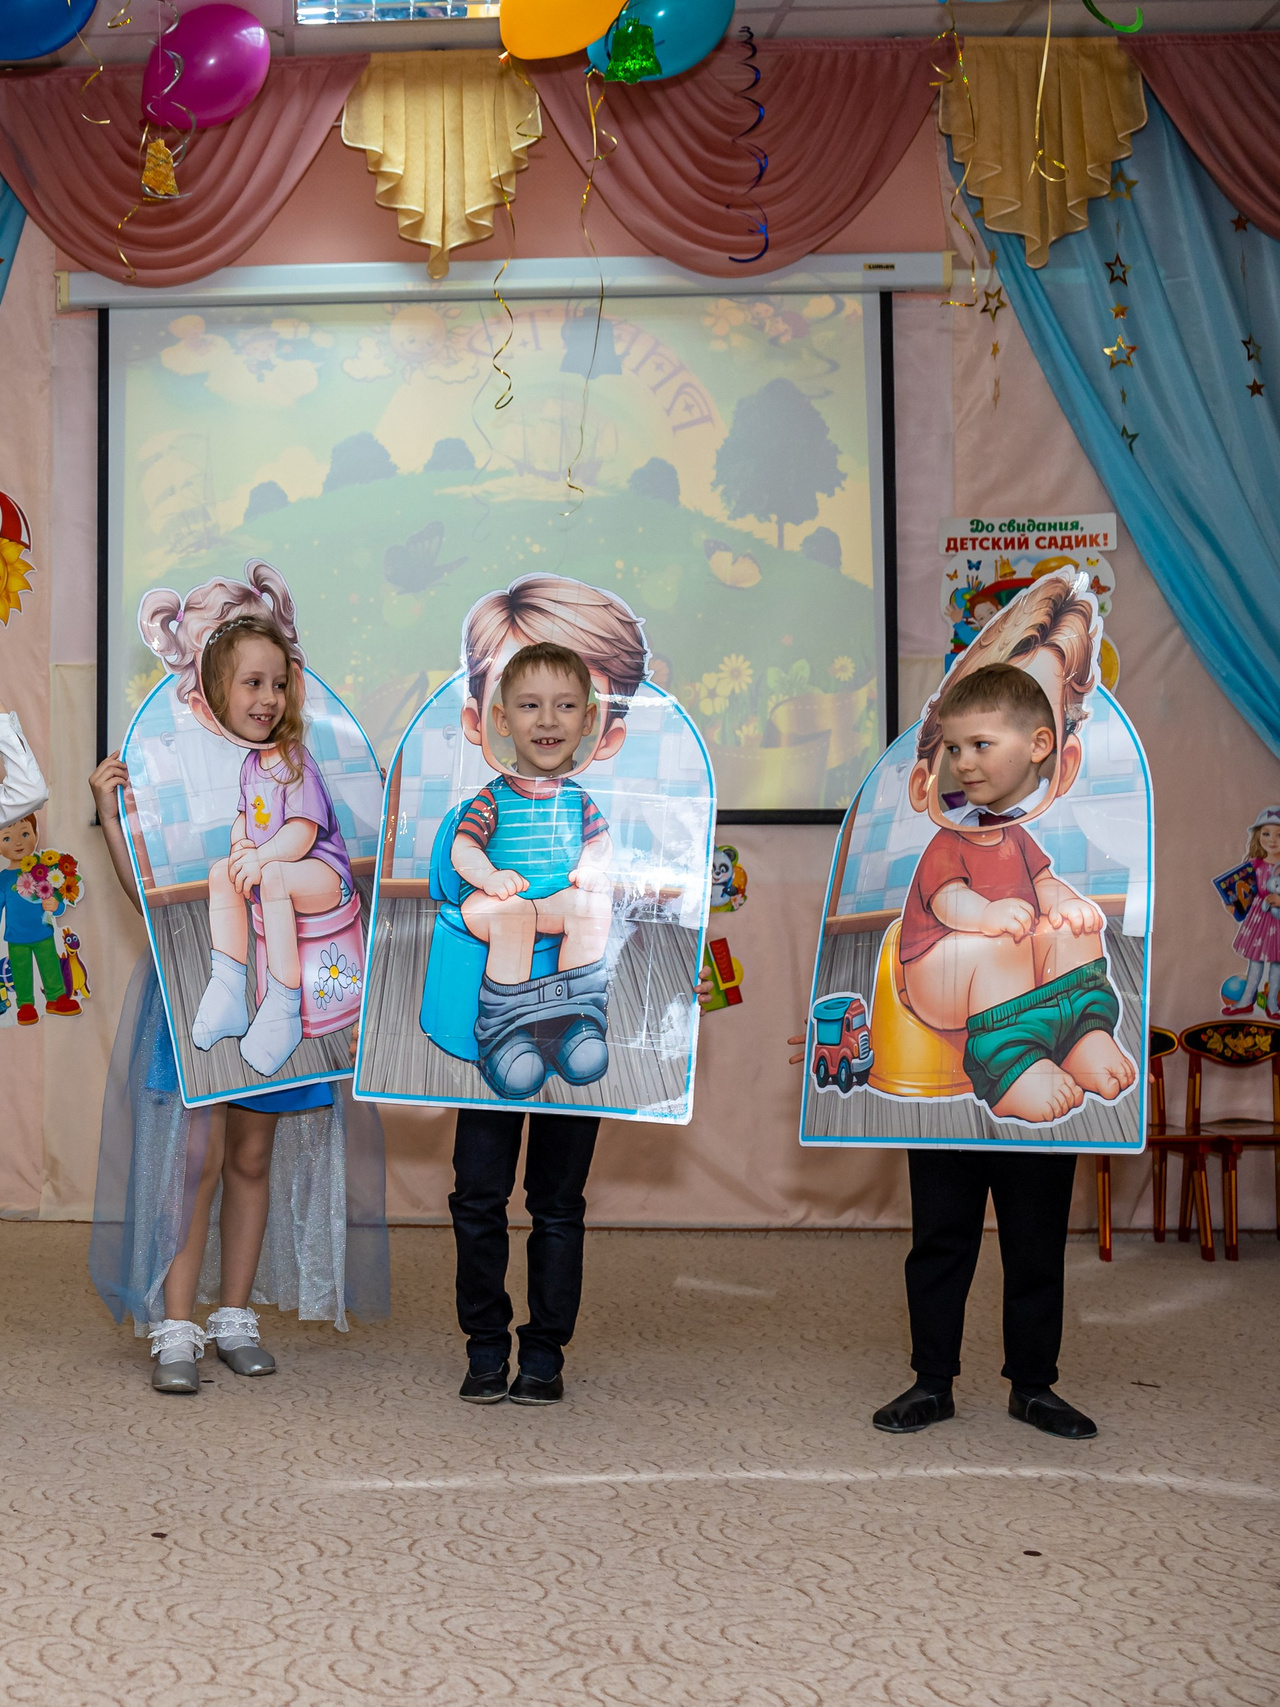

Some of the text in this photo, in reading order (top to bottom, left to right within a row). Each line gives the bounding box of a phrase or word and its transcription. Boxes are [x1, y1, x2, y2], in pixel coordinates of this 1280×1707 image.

[970, 518, 1084, 533] До свидания,
[945, 532, 1109, 553] ДЕТСКИЙ САДИК!
